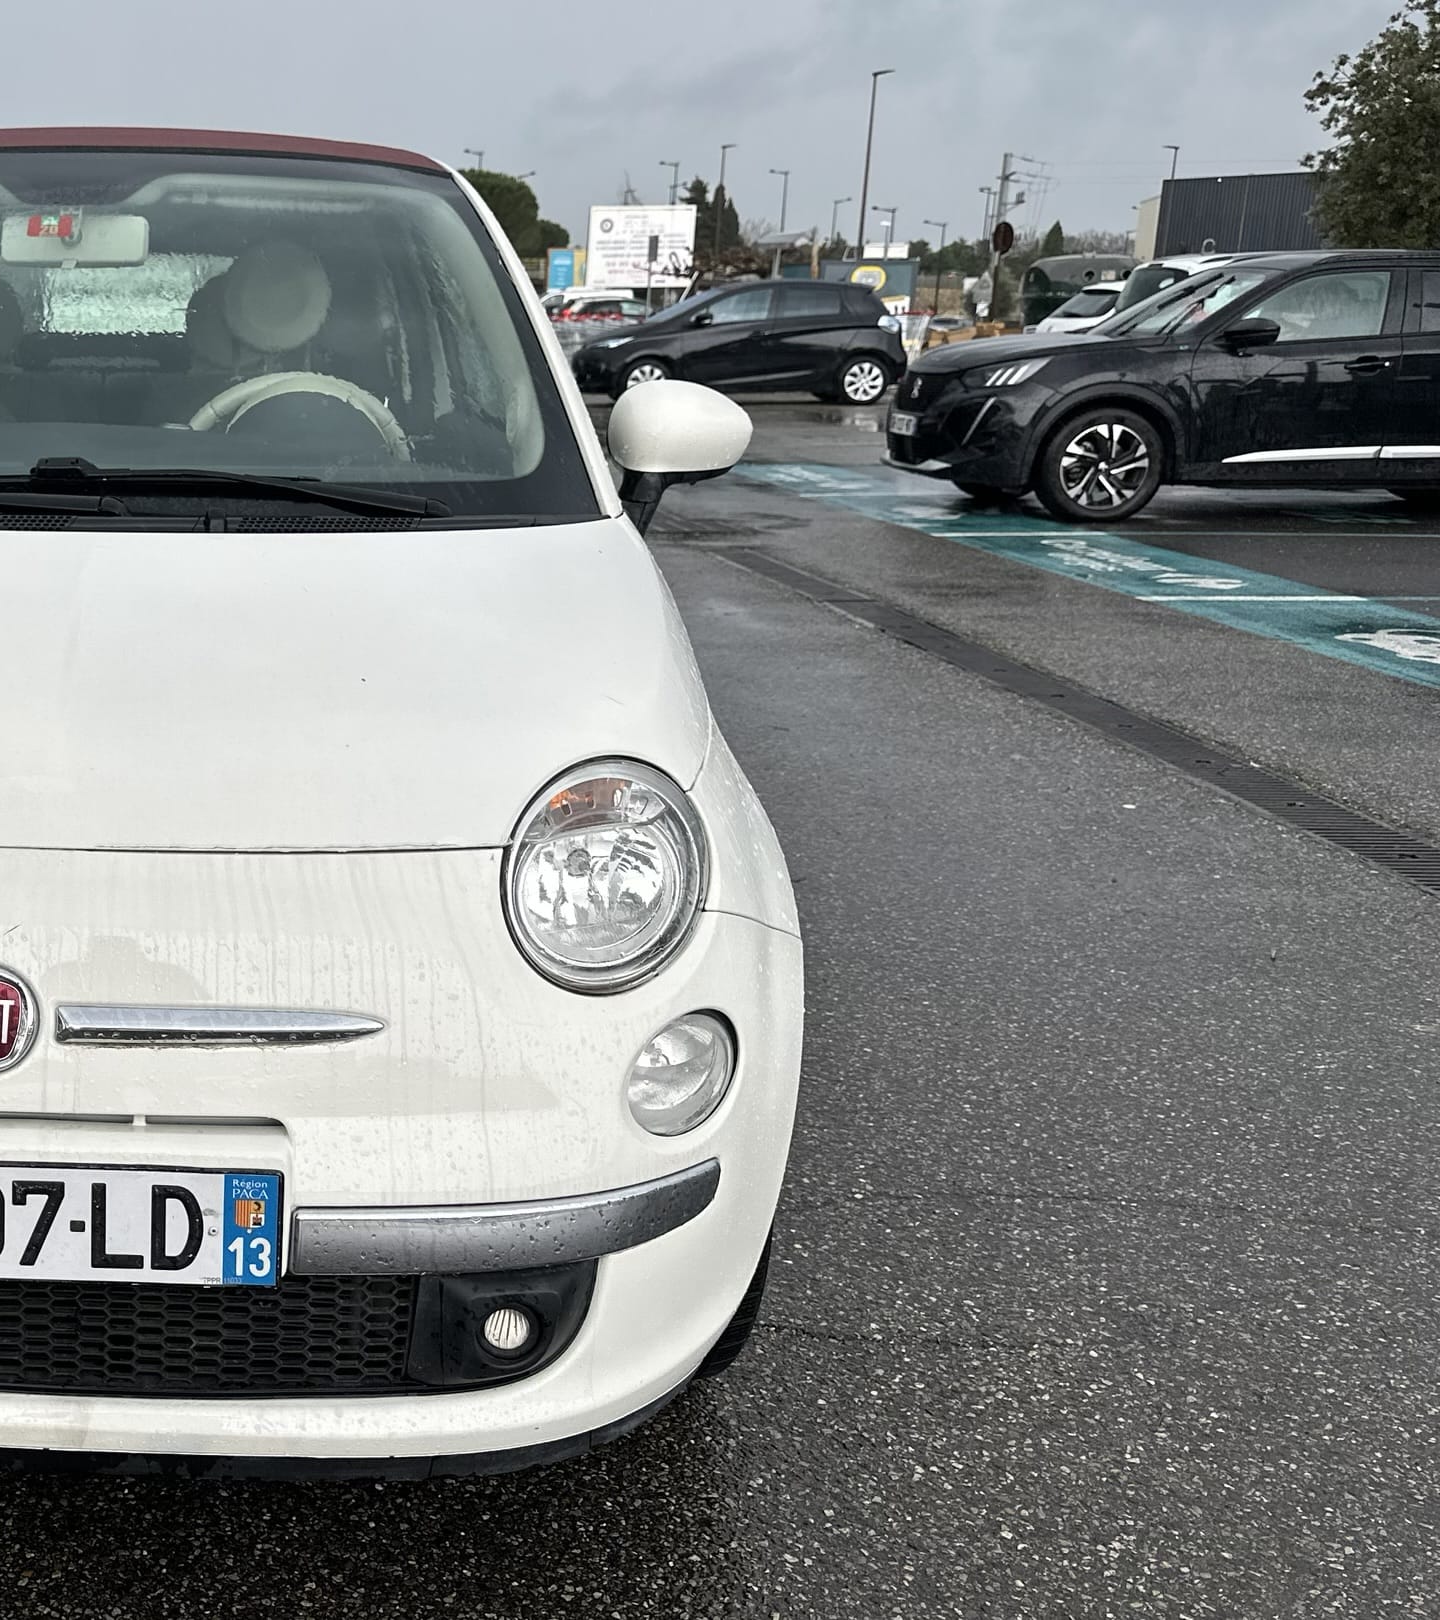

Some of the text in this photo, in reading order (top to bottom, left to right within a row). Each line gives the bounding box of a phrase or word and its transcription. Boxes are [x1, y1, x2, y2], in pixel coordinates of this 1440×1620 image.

[232, 1179, 268, 1191] Région
[232, 1188, 269, 1200] PACA
[227, 1236, 272, 1278] 13
